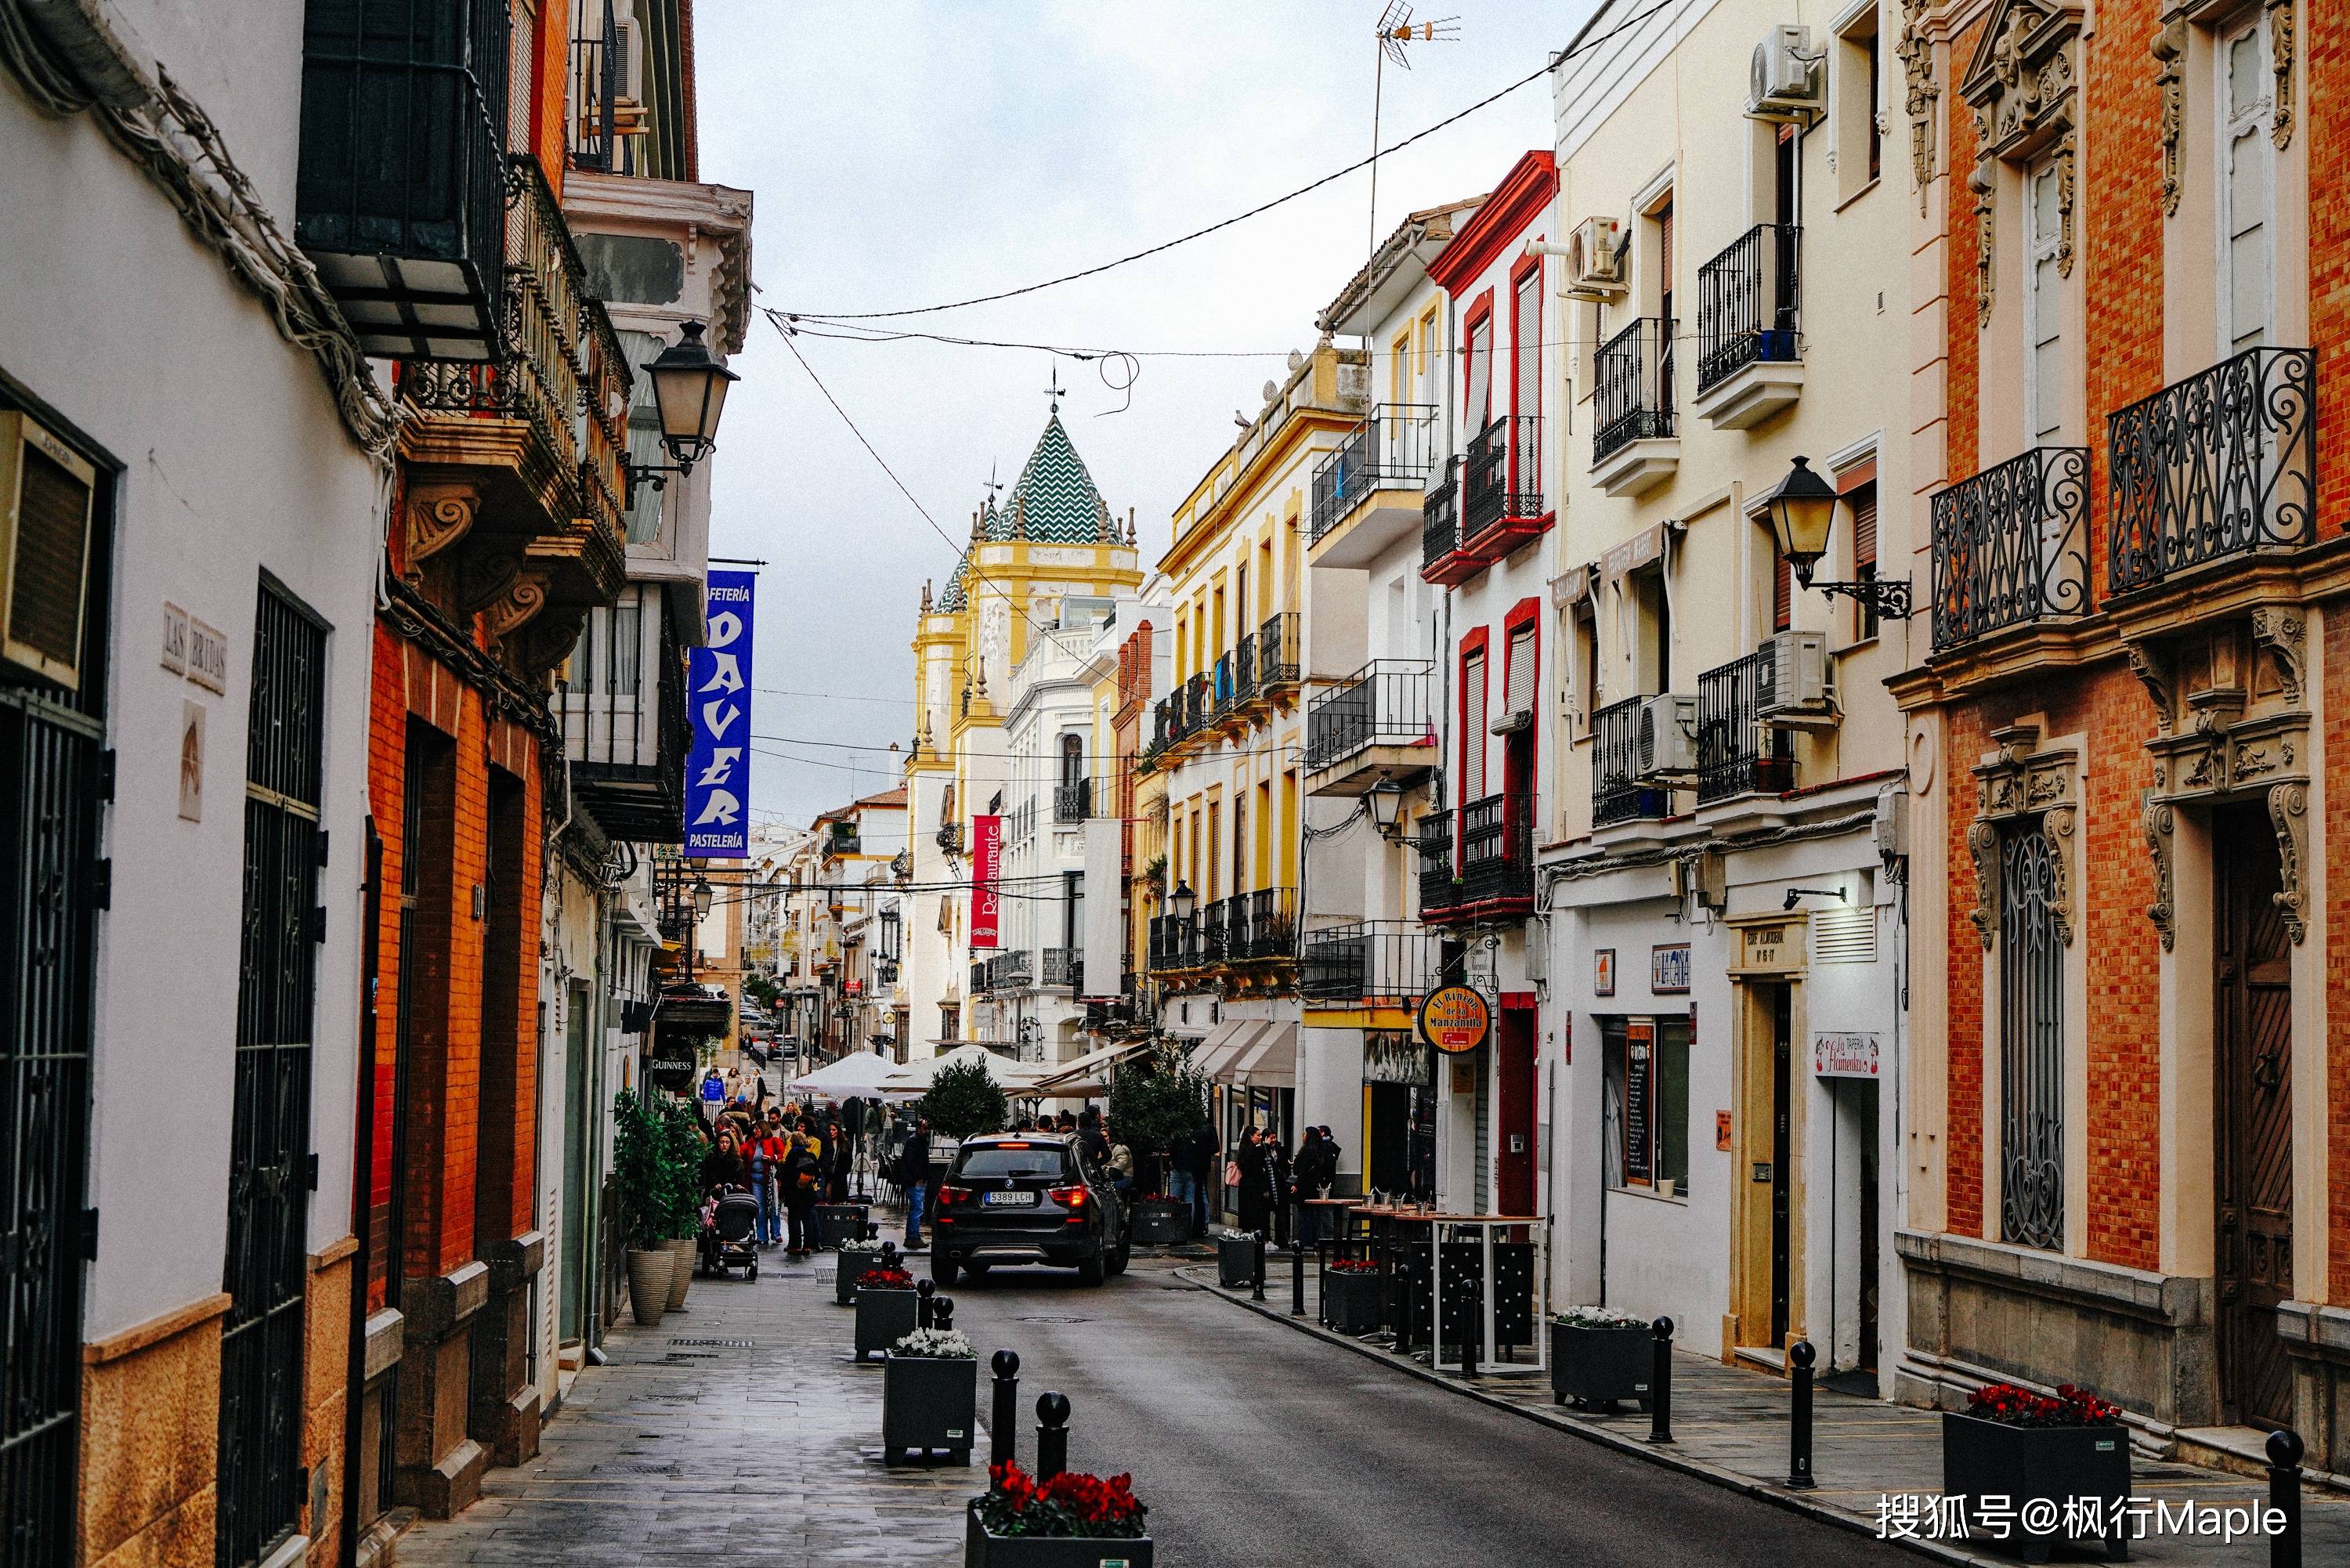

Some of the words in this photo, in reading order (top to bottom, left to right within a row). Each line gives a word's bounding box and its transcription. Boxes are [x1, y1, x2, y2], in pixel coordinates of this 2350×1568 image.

[692, 610, 745, 826] DAVER
[689, 832, 743, 848] PASTELERÍA
[982, 825, 999, 916] Restaurante
[1432, 998, 1444, 1010] El
[1444, 991, 1479, 1010] Rincón
[1446, 1007, 1455, 1016] de
[1459, 1007, 1466, 1016] la
[1430, 1017, 1482, 1028] Manzanilla
[652, 1059, 692, 1071] GUINNESS
[992, 1193, 1013, 1201] 5389
[1014, 1192, 1031, 1201] LCH
